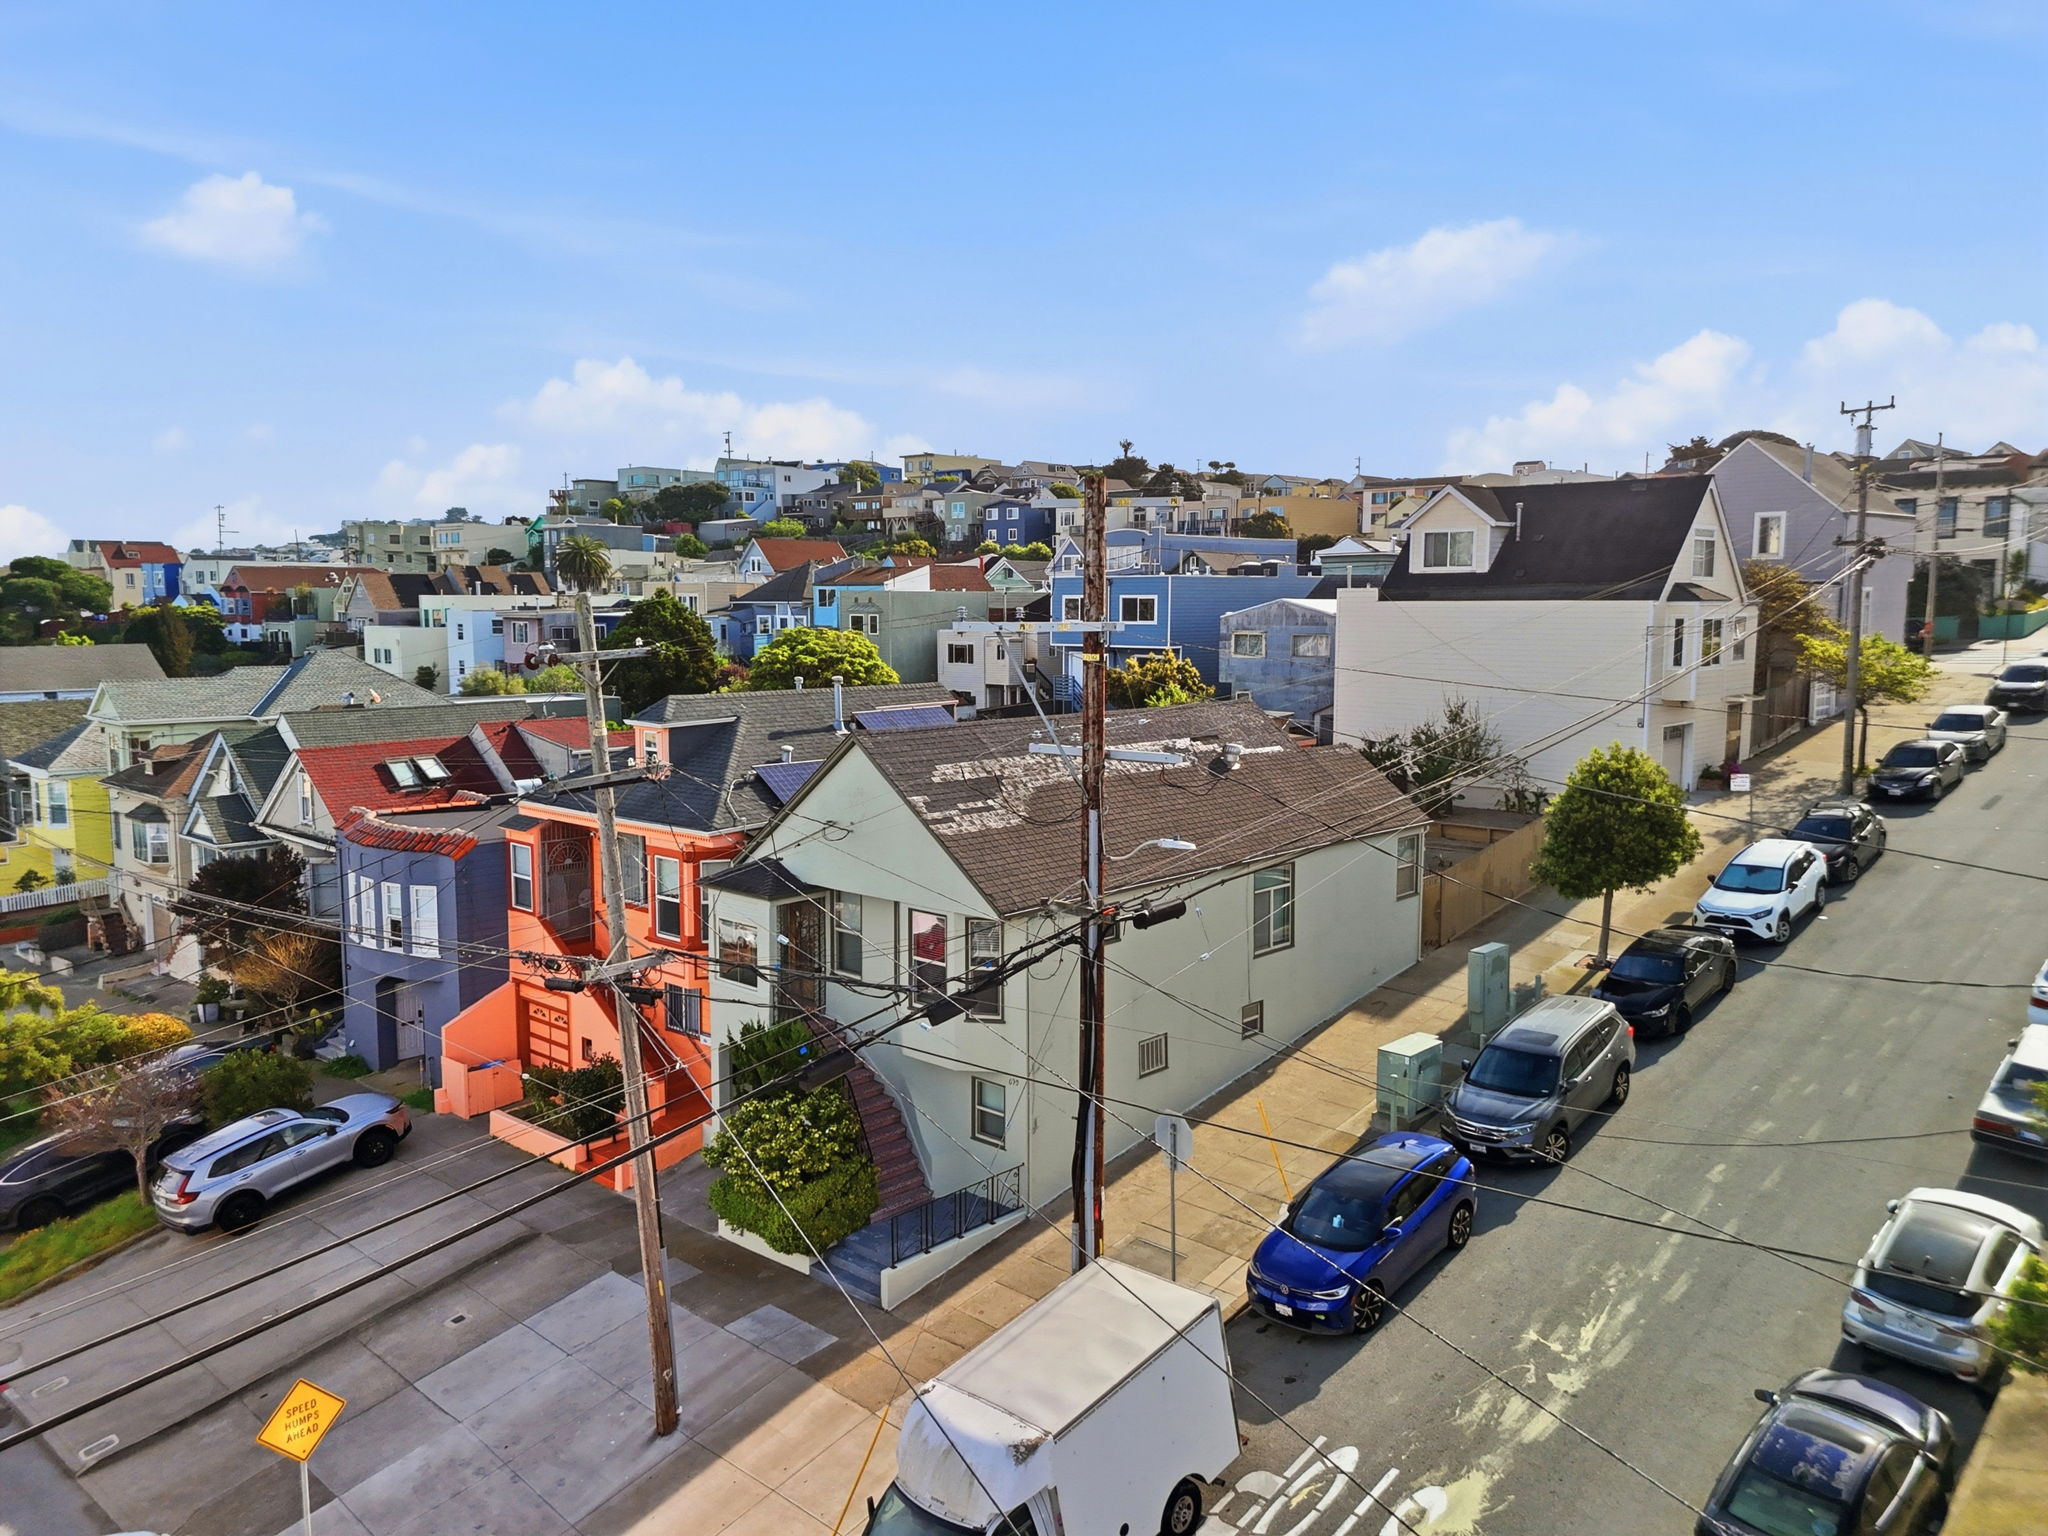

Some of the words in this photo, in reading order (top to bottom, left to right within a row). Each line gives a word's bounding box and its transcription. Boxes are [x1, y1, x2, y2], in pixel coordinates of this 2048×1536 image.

[286, 1398, 317, 1419] SPEED
[284, 1409, 320, 1431] HUMPS
[286, 1422, 319, 1444] AHEAD
